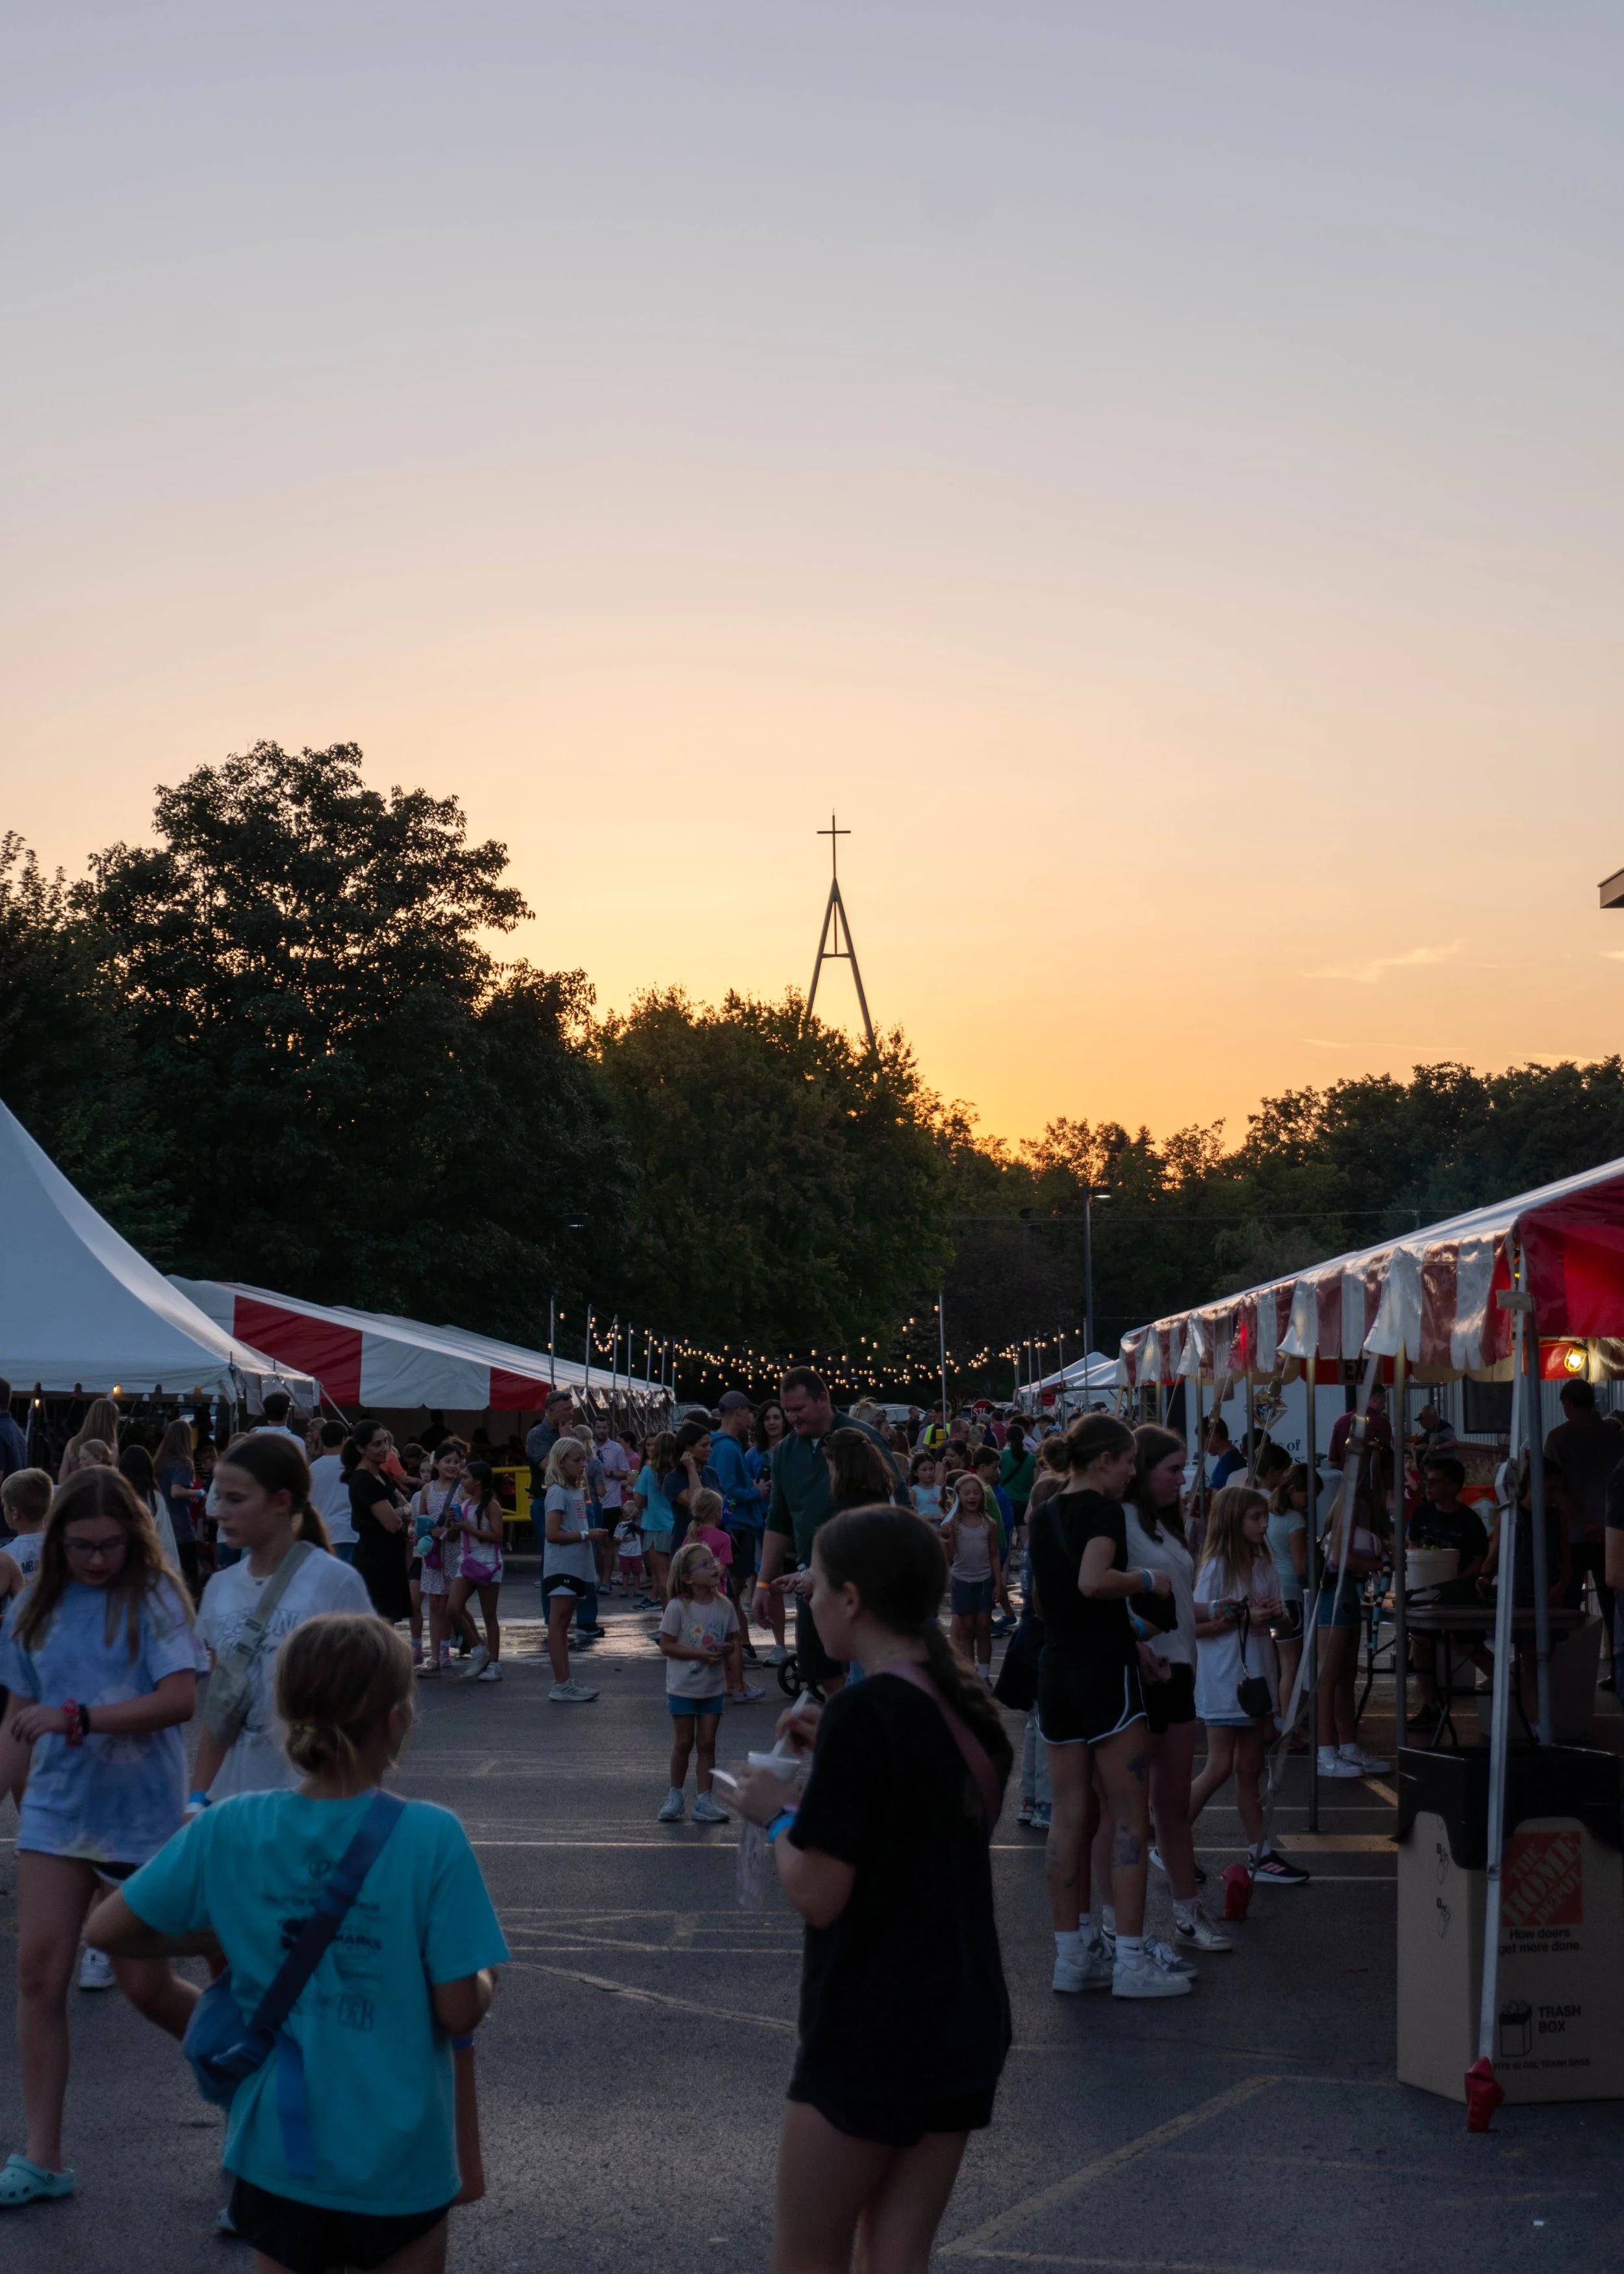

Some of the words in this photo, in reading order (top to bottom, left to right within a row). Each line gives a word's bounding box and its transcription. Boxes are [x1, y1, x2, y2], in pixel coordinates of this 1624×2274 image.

[1287, 1439, 1300, 1451] of
[1508, 1843, 1542, 1880] THE
[1501, 1830, 1581, 1927] HOME
[1534, 1866, 1581, 1926] DEPOT
[1510, 1928, 1534, 1939] How
[1538, 1928, 1569, 1938] doers
[1501, 1943, 1516, 1954] get
[1519, 1943, 1549, 1953] more
[1552, 1940, 1582, 1951] done.
[1538, 2005, 1581, 2017] TRASH
[1539, 2021, 1566, 2033] BOX
